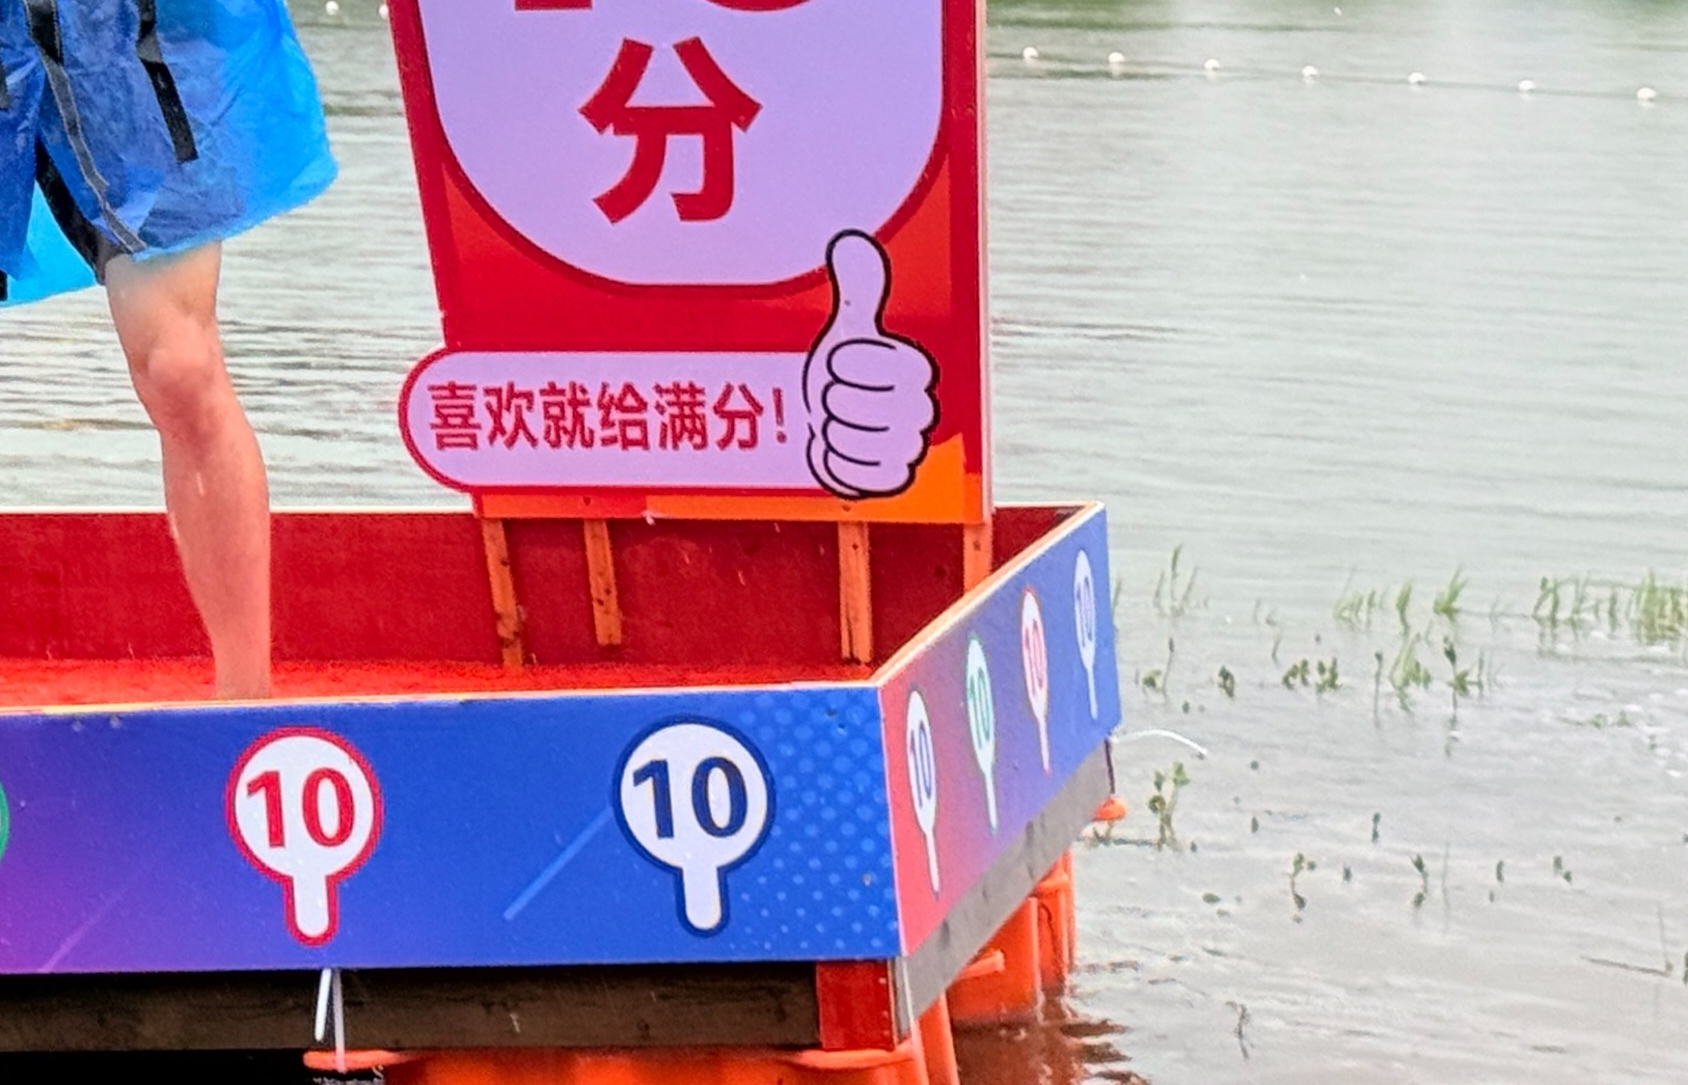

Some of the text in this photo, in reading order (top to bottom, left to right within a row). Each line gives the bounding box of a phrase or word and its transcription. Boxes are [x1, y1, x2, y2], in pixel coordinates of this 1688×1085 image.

[578, 36, 763, 225] 分
[427, 380, 788, 452] 喜欢就给满分!
[968, 667, 991, 750] 10
[631, 755, 749, 841] 10
[910, 720, 932, 809] 10
[245, 767, 355, 849] 10
